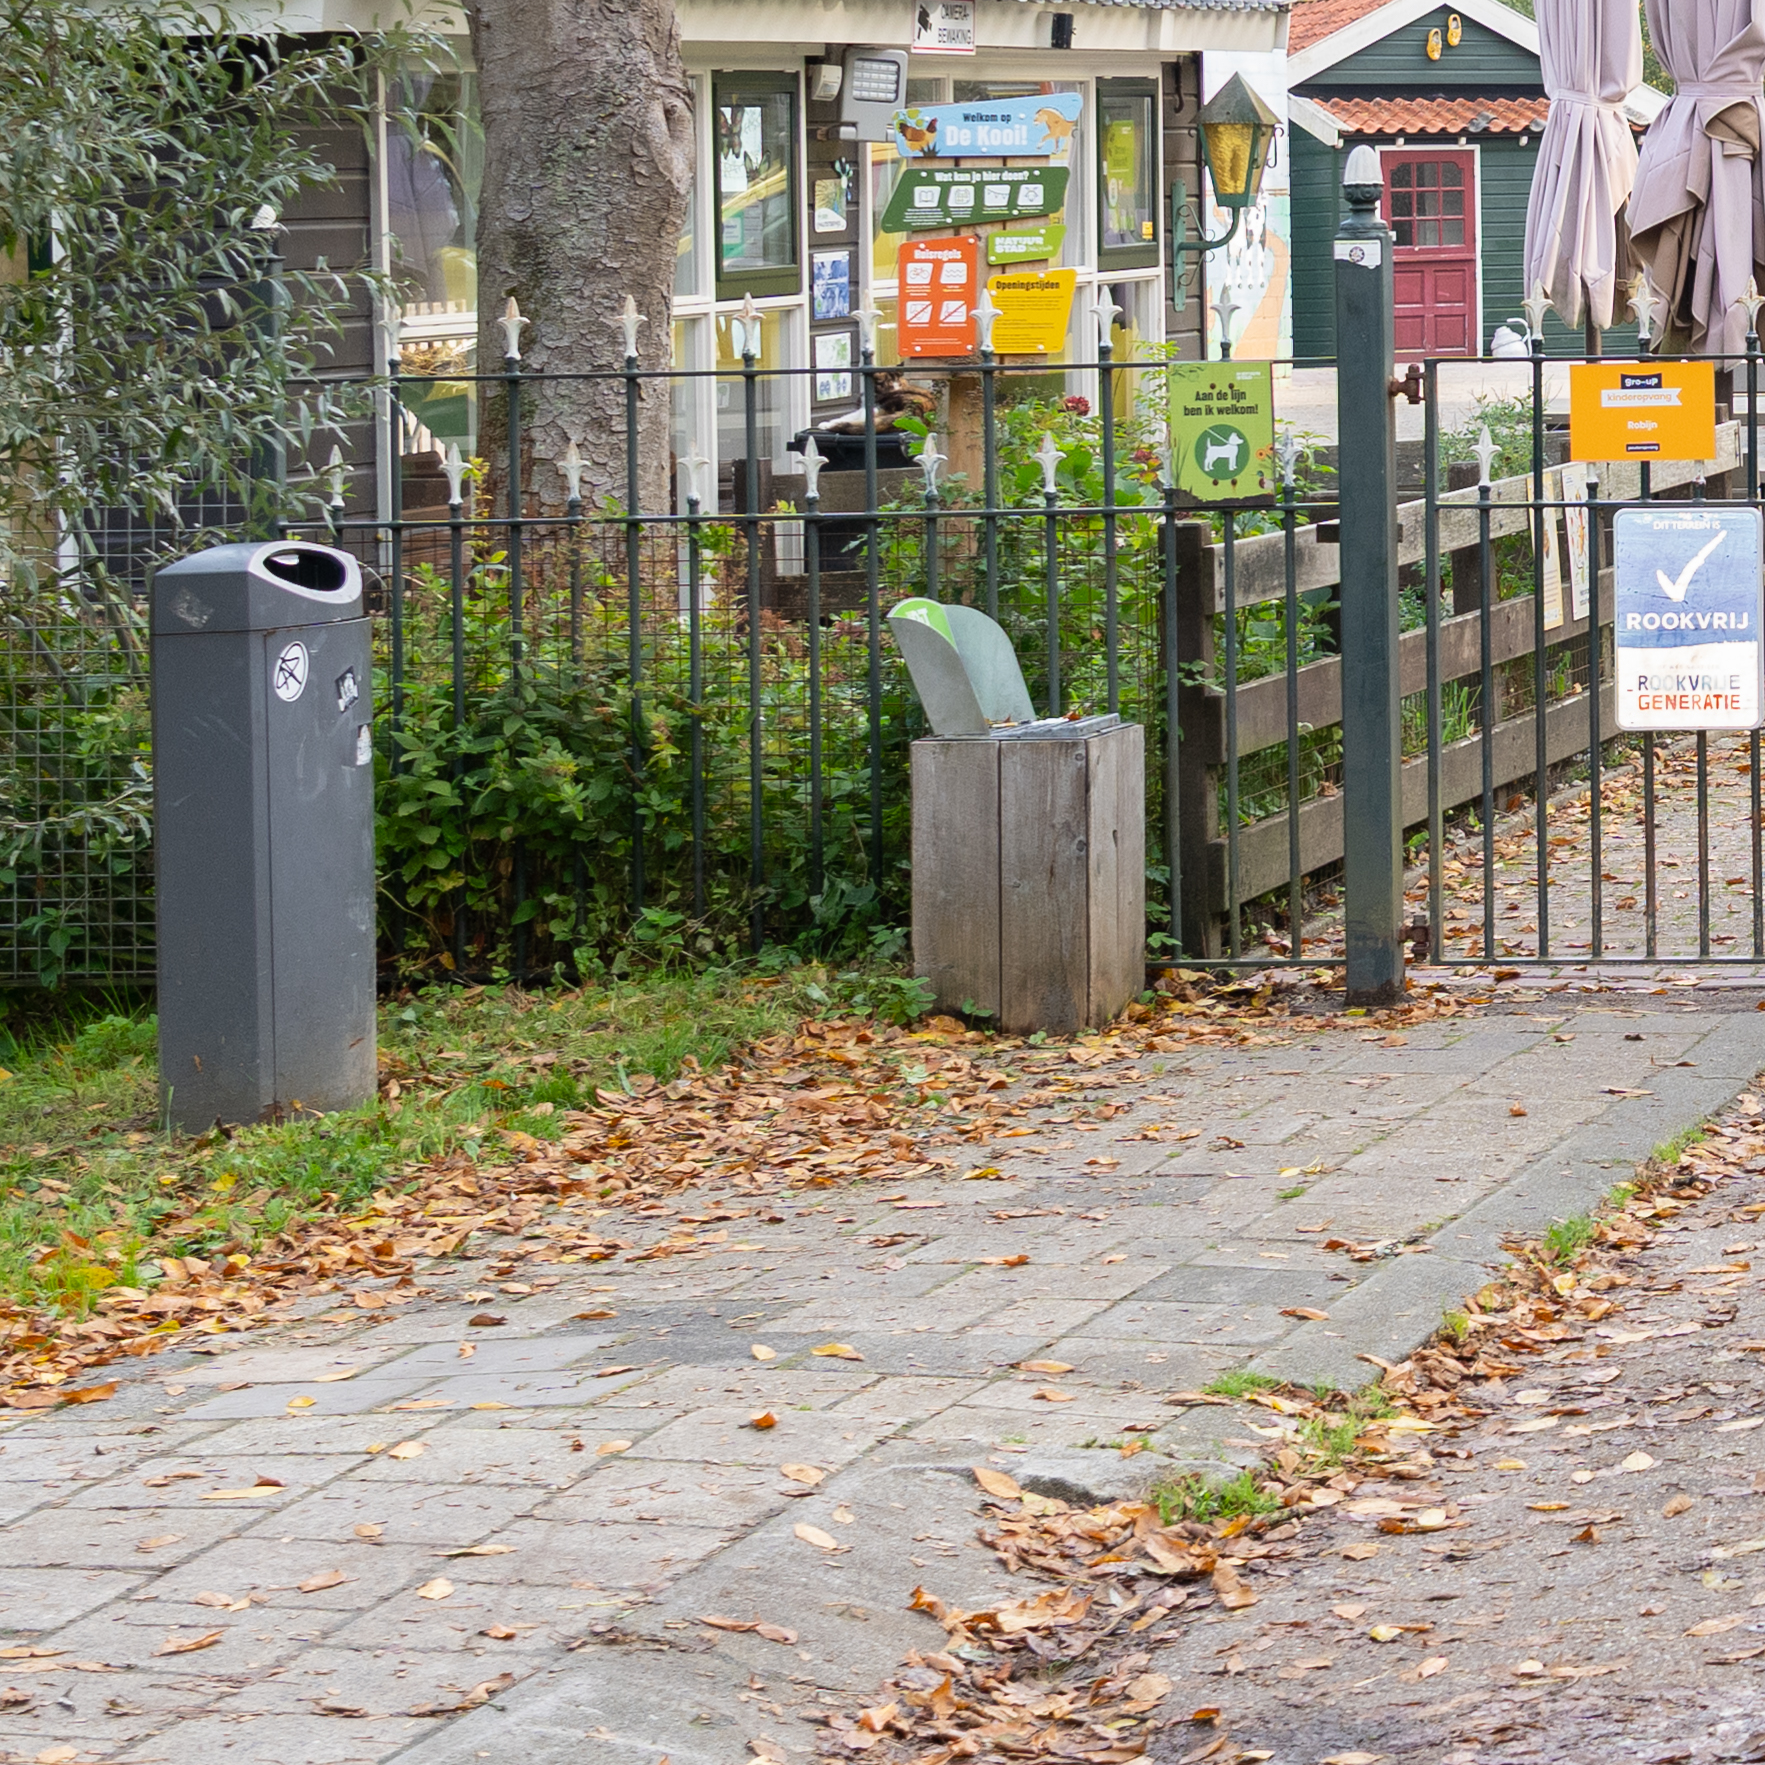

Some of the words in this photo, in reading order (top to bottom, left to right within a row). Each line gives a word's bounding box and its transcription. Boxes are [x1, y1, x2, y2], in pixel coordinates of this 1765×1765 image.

[938, 27, 971, 45] BEWAKING
[963, 112, 998, 123] Welkom
[1000, 113, 1012, 124] op
[945, 125, 971, 146] De
[977, 124, 1028, 146] Kooi!
[934, 172, 953, 182] Wat
[953, 171, 971, 182] kun
[971, 171, 982, 184] je
[982, 171, 1001, 181] hier
[1001, 171, 1029, 181] doen?
[994, 236, 1044, 246] NATUUR
[994, 244, 1026, 253] STAD
[996, 280, 1060, 292] Openingstijden
[1195, 391, 1214, 401] Aan
[1216, 390, 1228, 401] de
[1231, 389, 1246, 403] lijn
[1607, 392, 1672, 403] kinderopvang
[1183, 406, 1202, 416] ben
[1204, 405, 1215, 415] ik
[1216, 404, 1259, 415] welkom!
[1627, 420, 1658, 431] Robijn
[1653, 520, 1670, 530] DIT
[1672, 520, 1711, 530] TERREIN
[1712, 520, 1721, 530] IS
[1626, 611, 1749, 630] ROOKVRIJ
[1638, 674, 1741, 691] ROOKVRIJE
[1638, 694, 1741, 710] GENERATIE
